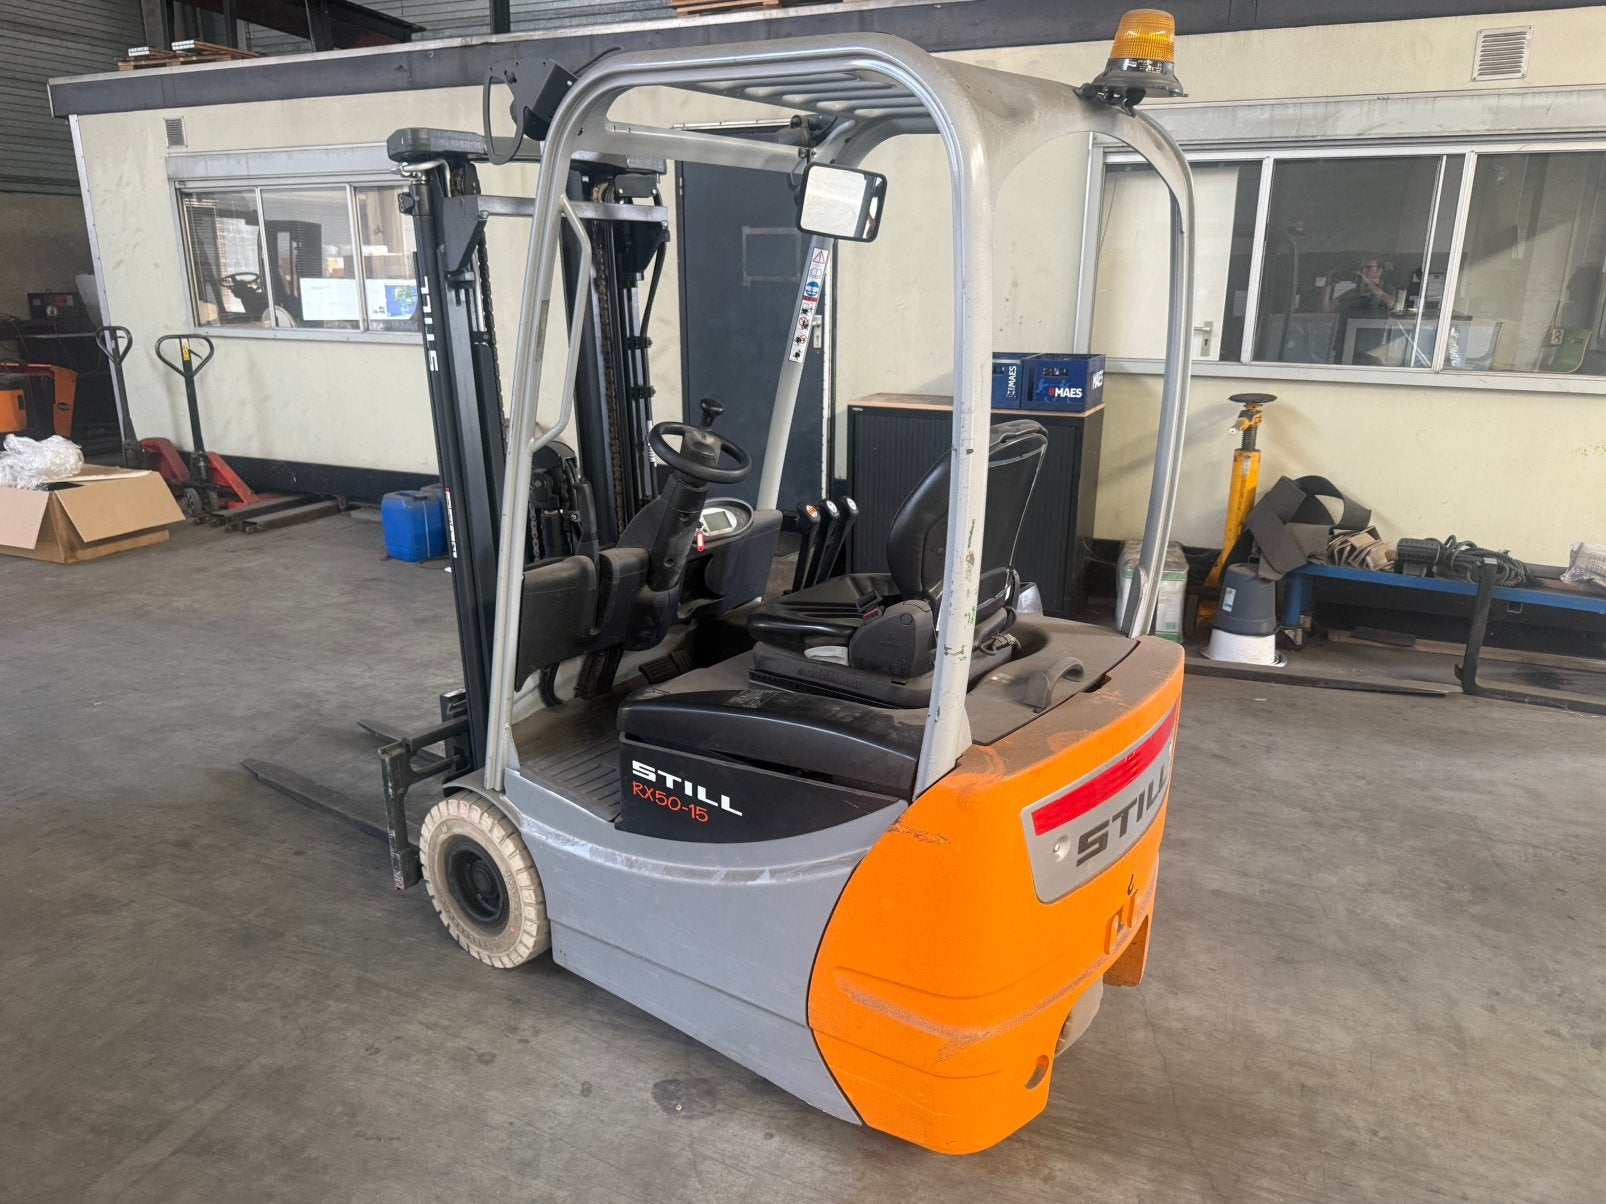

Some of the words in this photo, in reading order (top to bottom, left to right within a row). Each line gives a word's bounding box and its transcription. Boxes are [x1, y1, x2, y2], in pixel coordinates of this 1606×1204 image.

[421, 275, 439, 372] STILL
[1054, 387, 1083, 398] MAES
[632, 760, 743, 817] STILL
[632, 780, 709, 823] RX50-15
[1076, 763, 1167, 867] STILL
